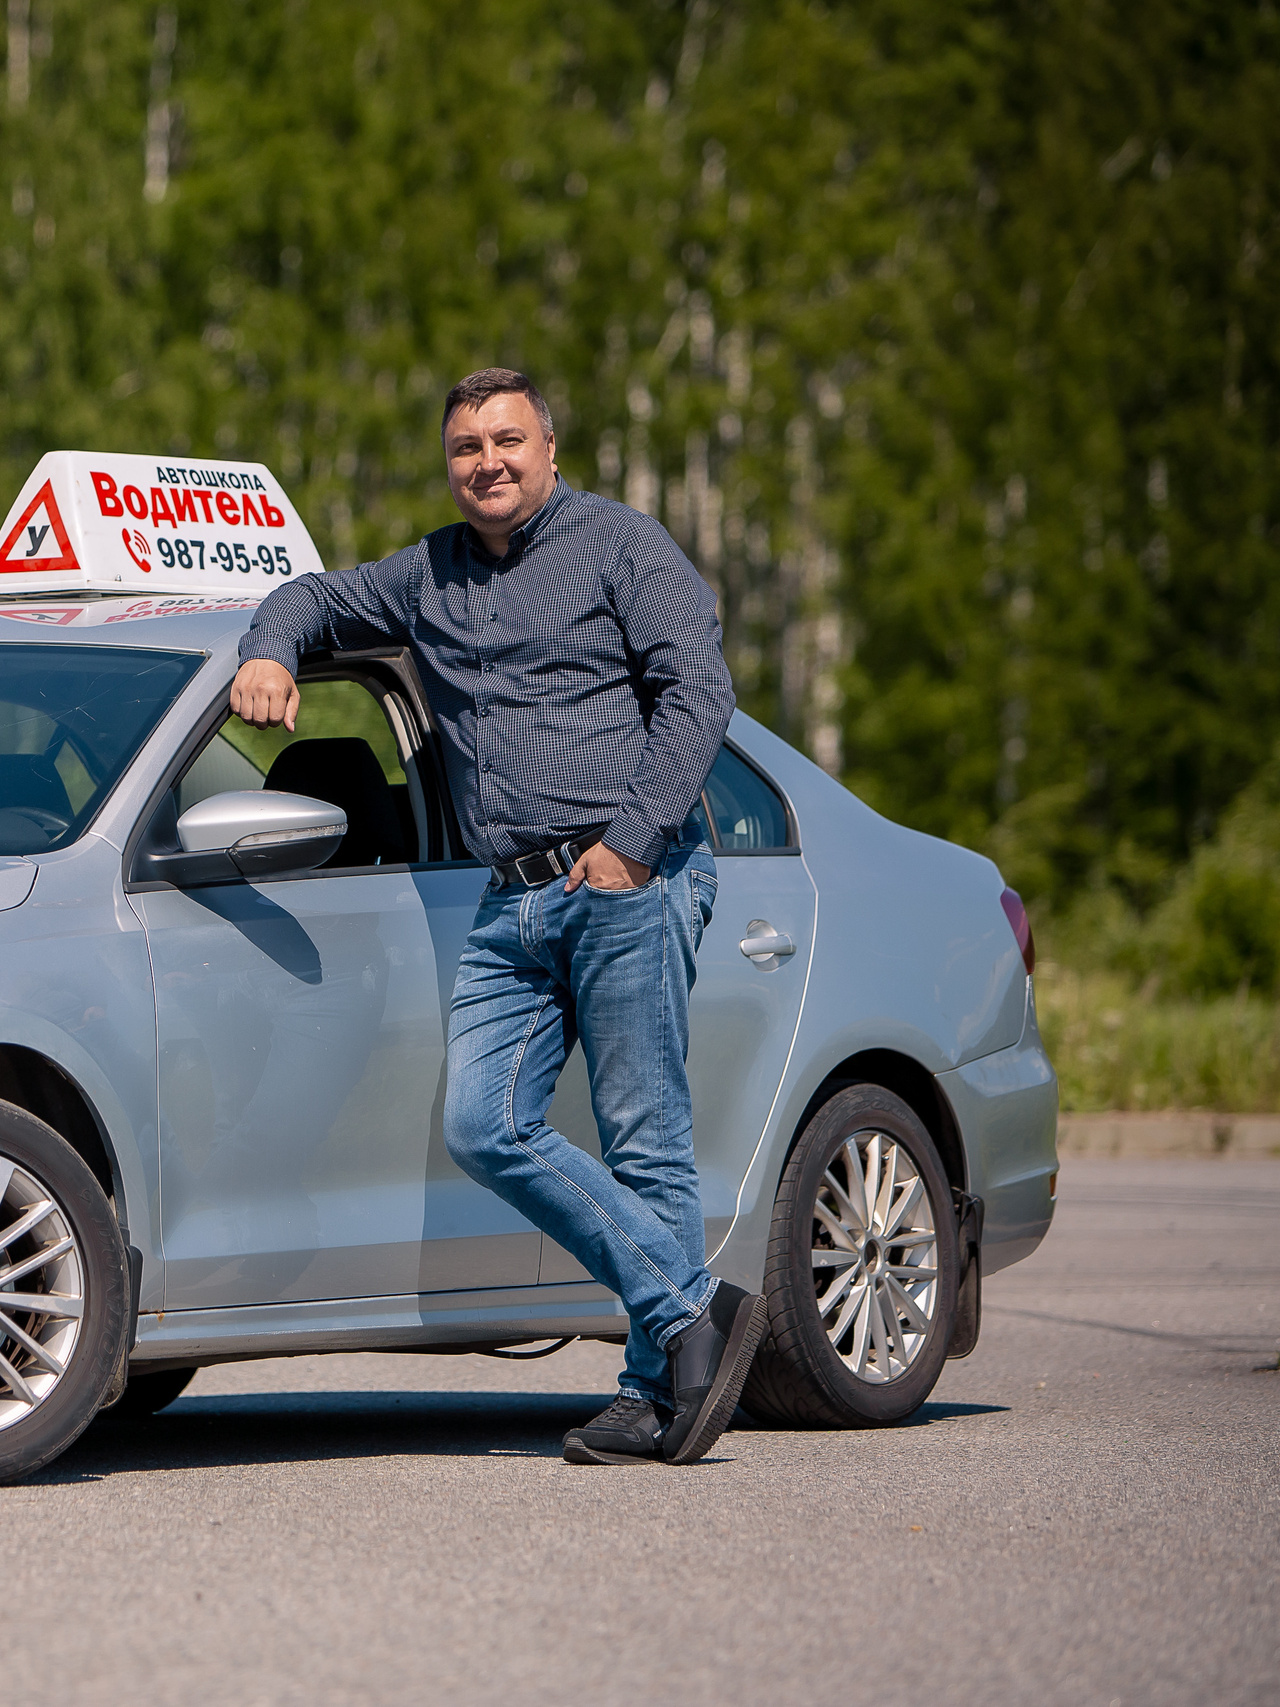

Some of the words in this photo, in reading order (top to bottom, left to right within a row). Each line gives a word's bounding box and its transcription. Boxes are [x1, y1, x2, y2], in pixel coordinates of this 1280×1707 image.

[156, 466, 266, 491] АВТОШКОЛА
[89, 471, 286, 529] Водитель
[157, 537, 292, 576] 987-95-95
